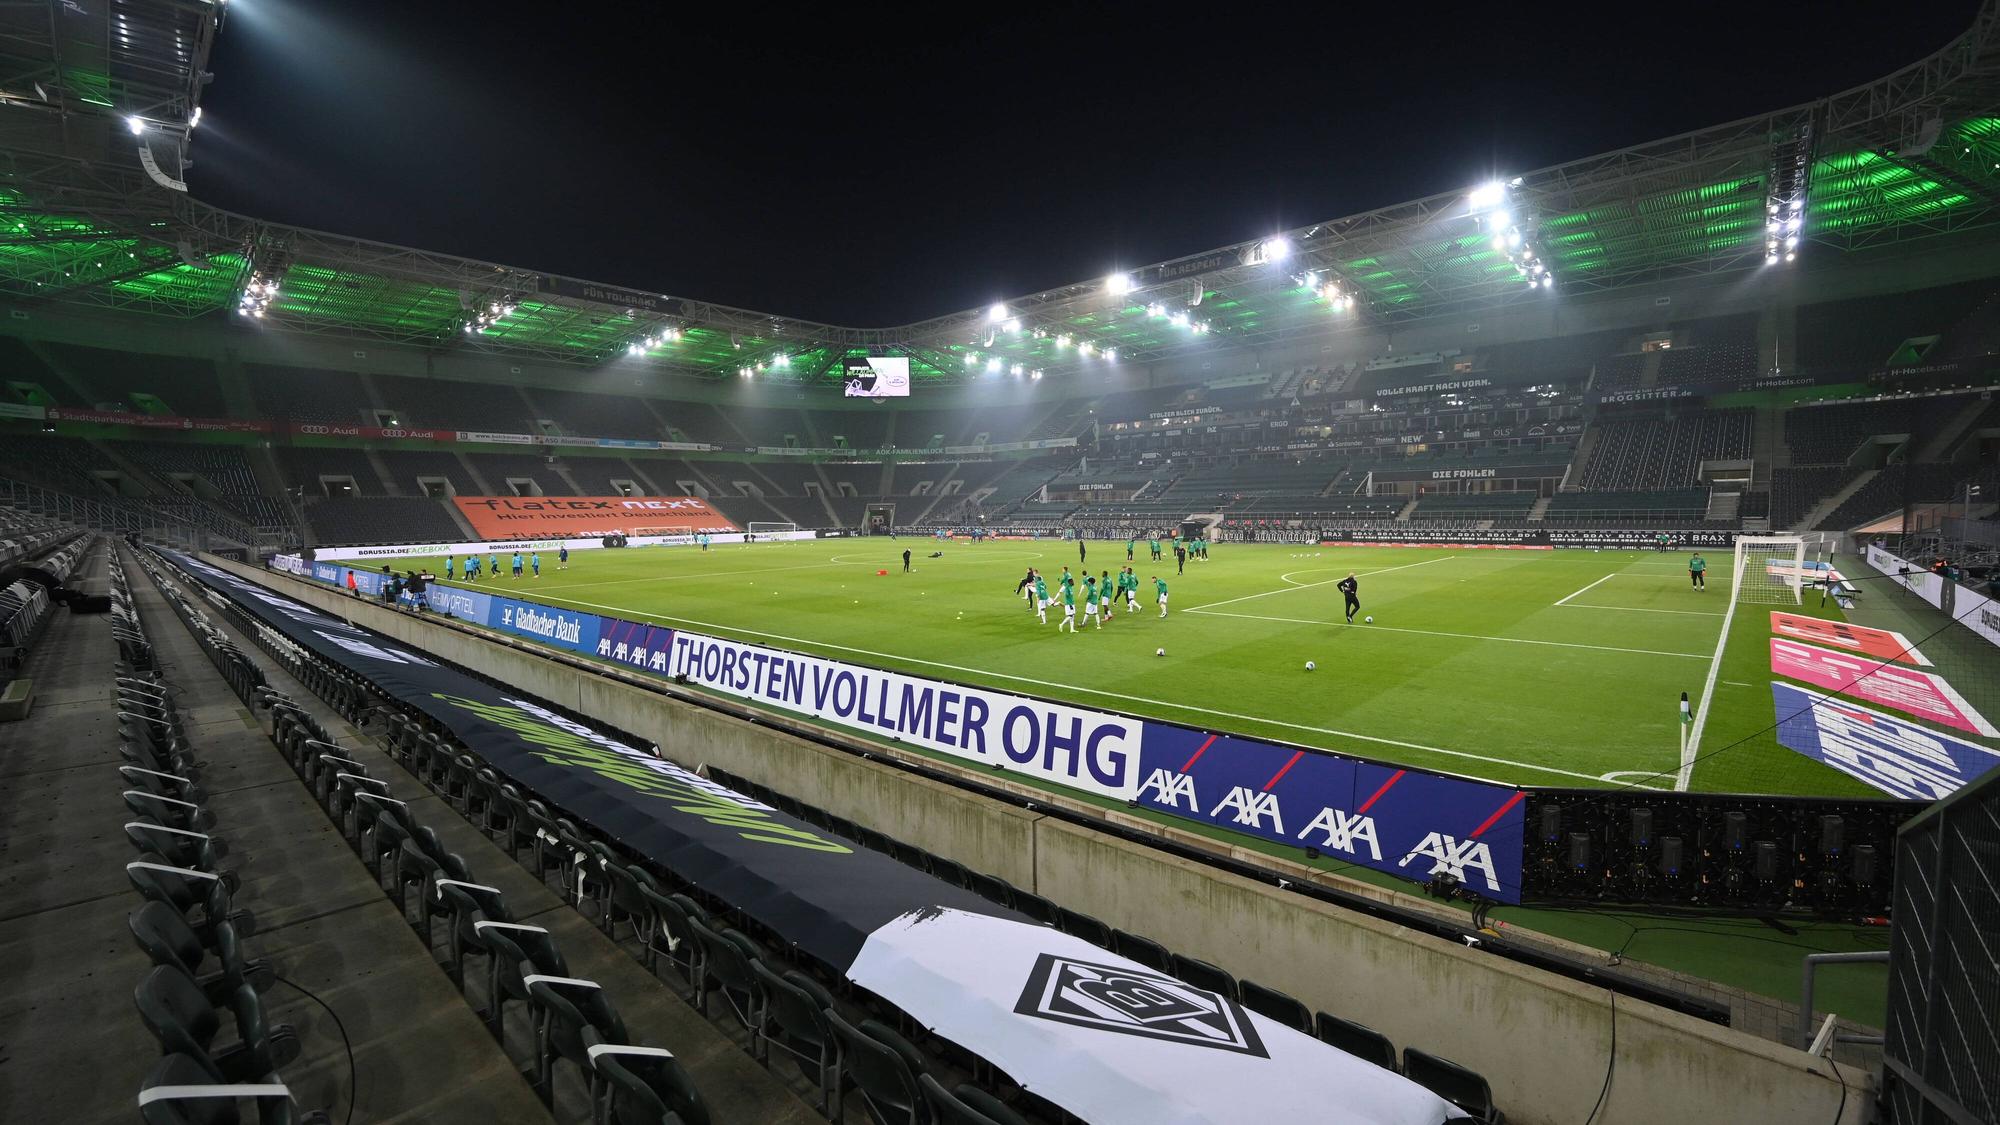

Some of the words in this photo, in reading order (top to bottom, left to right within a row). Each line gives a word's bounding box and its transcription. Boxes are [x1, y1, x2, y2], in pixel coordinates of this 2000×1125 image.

[1376, 388, 1404, 396] VOLLE
[1406, 385, 1434, 394] KRAFT
[1436, 382, 1460, 391] NACH
[1462, 379, 1491, 388] VORN.
[1756, 377, 1815, 388] H-Hotels.com
[1601, 390, 1692, 403] BROGSITTER.de
[1150, 411, 1175, 419] STOLZER
[1176, 409, 1194, 417] BLICK
[332, 427, 359, 436] Audi
[1270, 420, 1288, 428] ERGO
[409, 430, 434, 439] Audi
[1400, 435, 1423, 443] NEW
[1453, 469, 1496, 478] FOHLEN
[541, 511, 617, 519] investiert
[623, 509, 716, 518] Deutschland.
[1692, 534, 1726, 542] BRAX
[432, 593, 475, 615] HEIMVORTEIL
[516, 606, 556, 637] Gladbacher
[555, 618, 580, 644] Bank
[597, 638, 611, 656] AXA
[612, 642, 628, 661] AXA
[629, 646, 646, 667] AXA
[648, 651, 666, 672] AXA
[677, 637, 801, 705] THORSTEN
[813, 665, 989, 754] VOLLMER
[1002, 705, 1127, 788] OHG
[1137, 768, 1199, 812] AXA
[1210, 786, 1284, 835] AXA
[1298, 806, 1383, 861] AXA
[1398, 831, 1501, 892] AXA
